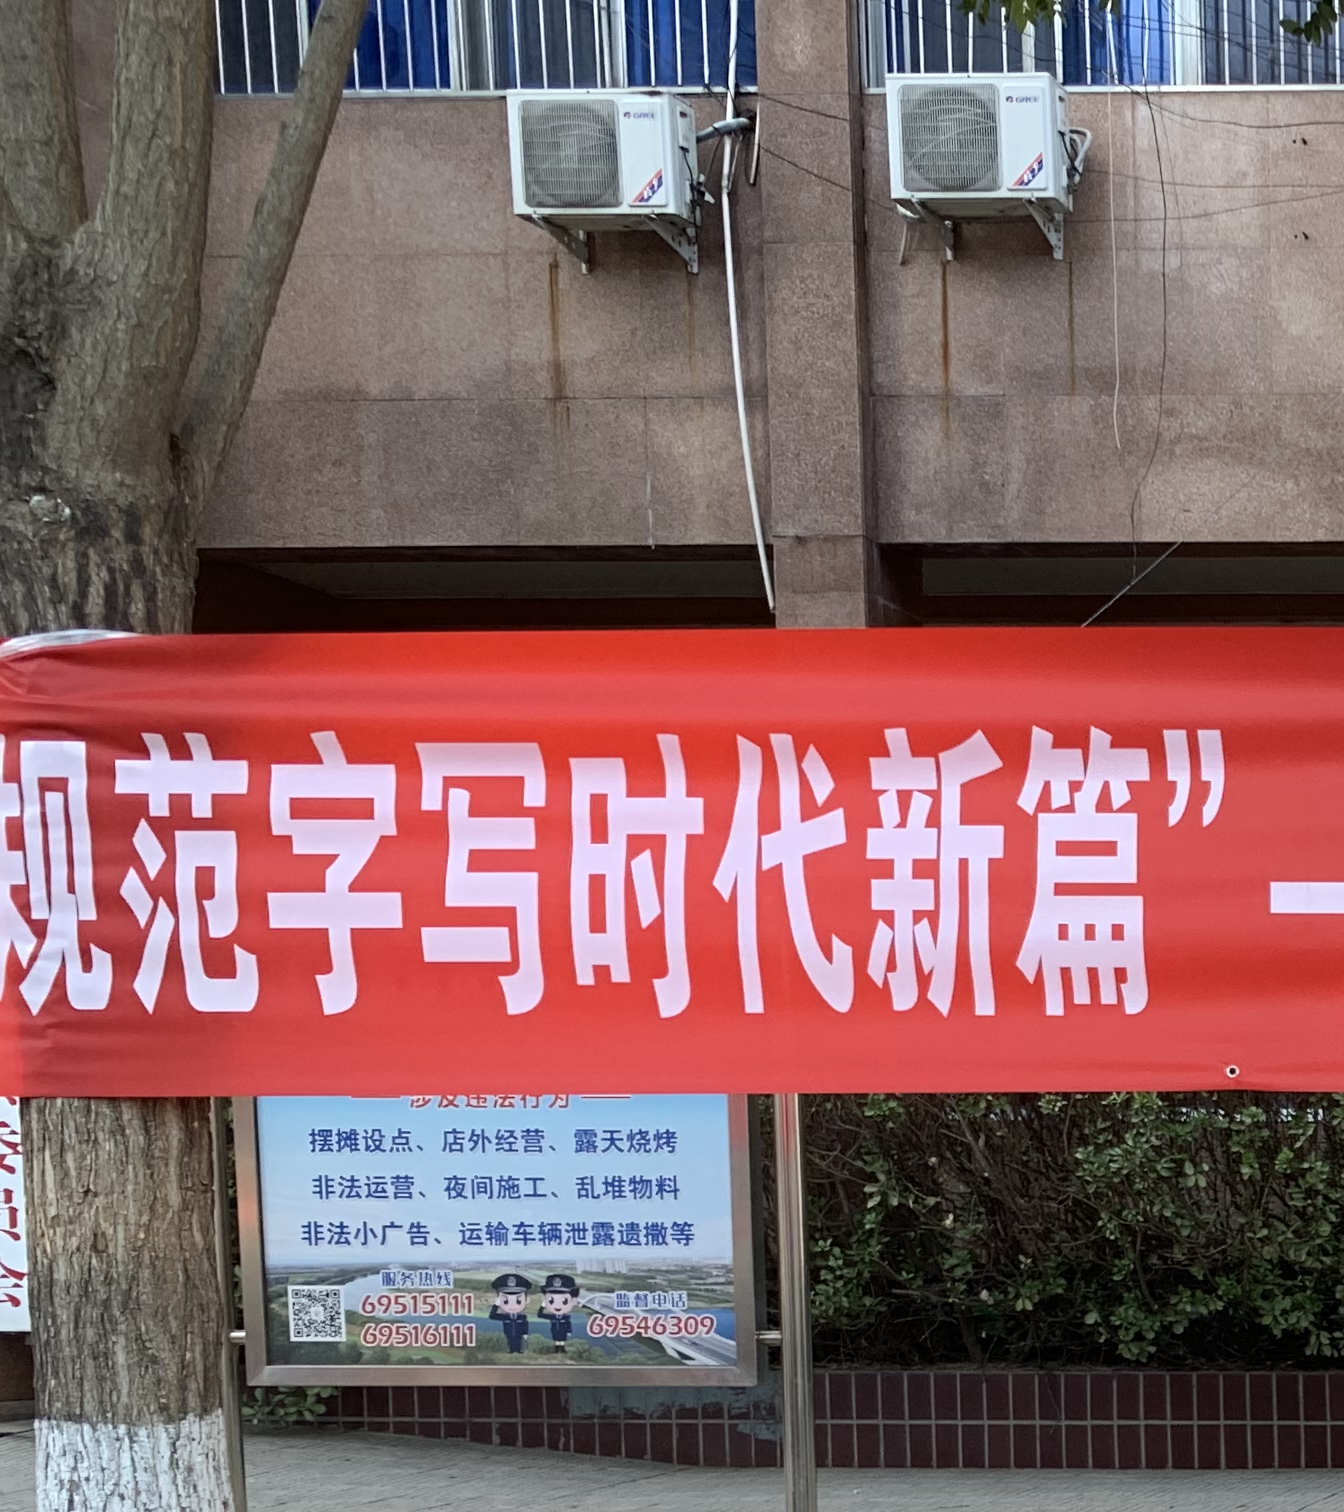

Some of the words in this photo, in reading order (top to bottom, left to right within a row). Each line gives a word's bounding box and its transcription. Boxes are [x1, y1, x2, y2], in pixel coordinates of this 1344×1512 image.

[380, 1270, 453, 1288] 服务热线
[361, 1293, 474, 1316] 69515111
[614, 1291, 688, 1310] 监督电话
[361, 1324, 477, 1346] 69516111
[587, 1314, 717, 1337] 69546309
